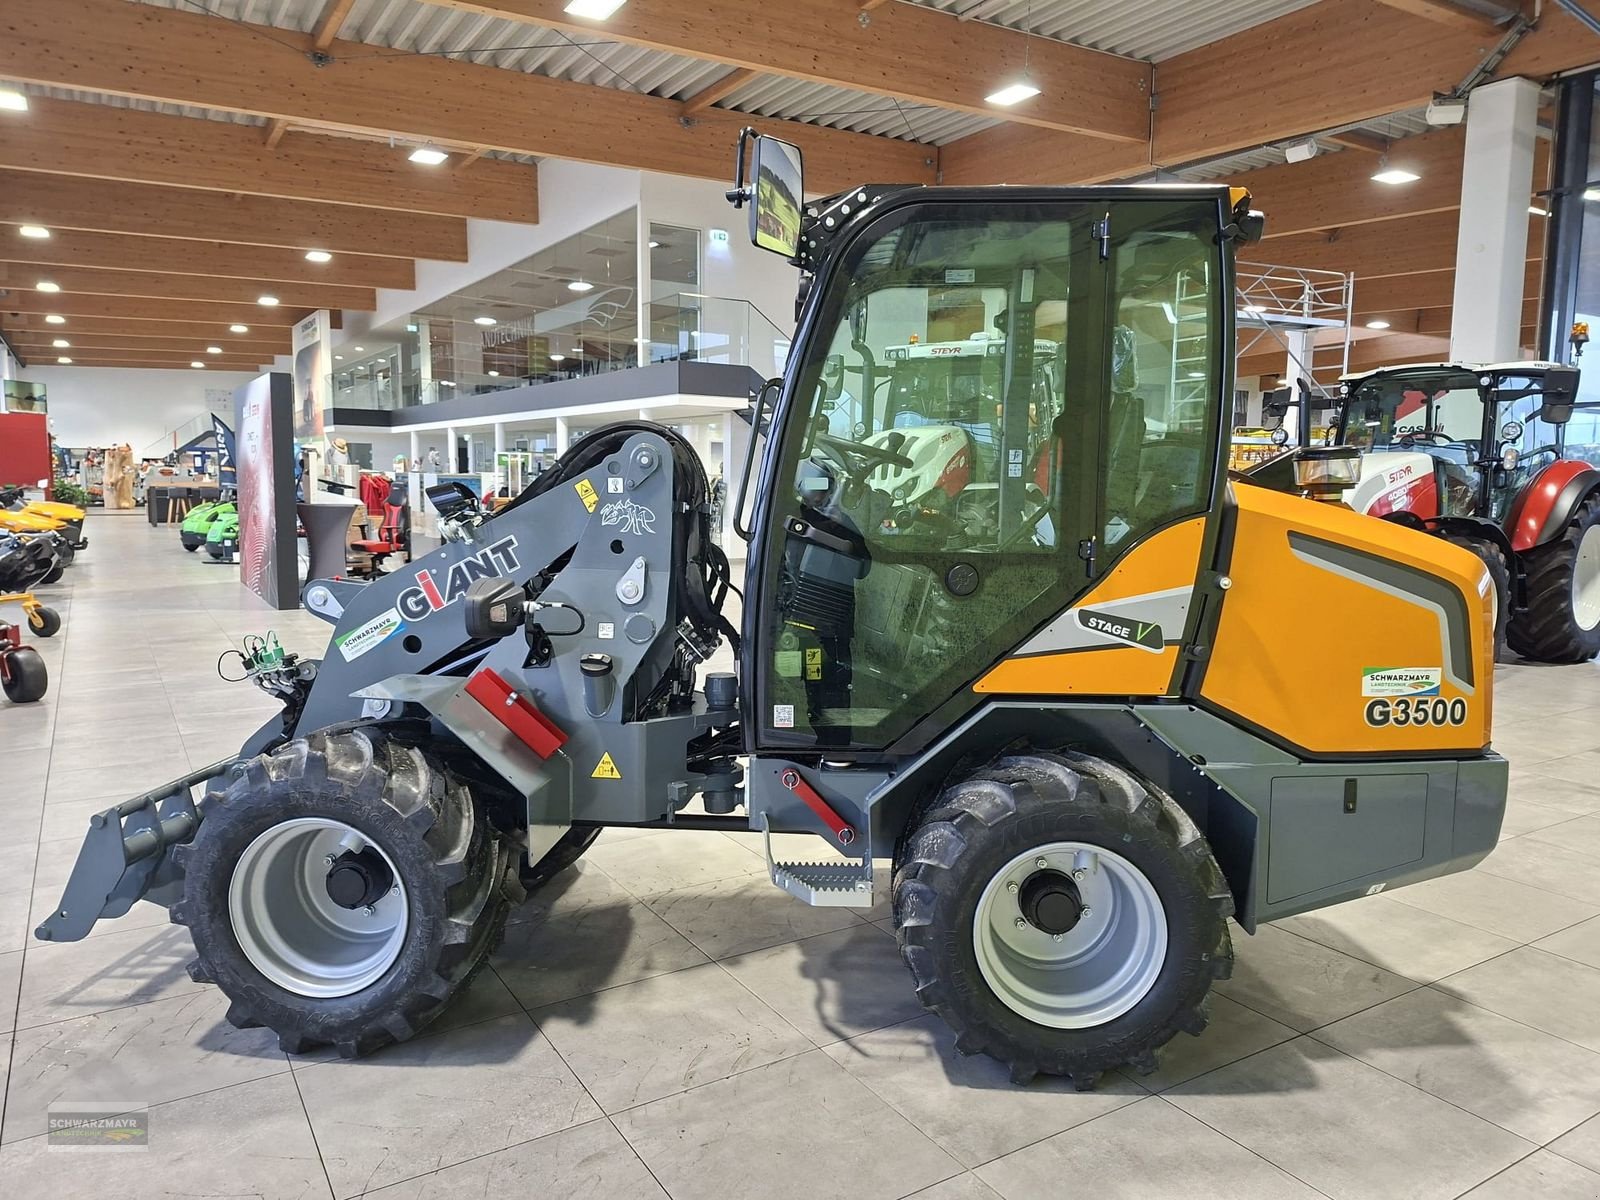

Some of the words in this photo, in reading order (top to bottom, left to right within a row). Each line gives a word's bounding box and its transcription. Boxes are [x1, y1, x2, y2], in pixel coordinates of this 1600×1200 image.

[931, 347, 961, 355] STEYR
[1389, 465, 1413, 483] STEYR
[344, 617, 391, 648] SCHWARZMAYR
[1087, 617, 1131, 638] STAGE
[1136, 622, 1157, 642] V
[1363, 697, 1468, 728] G3500
